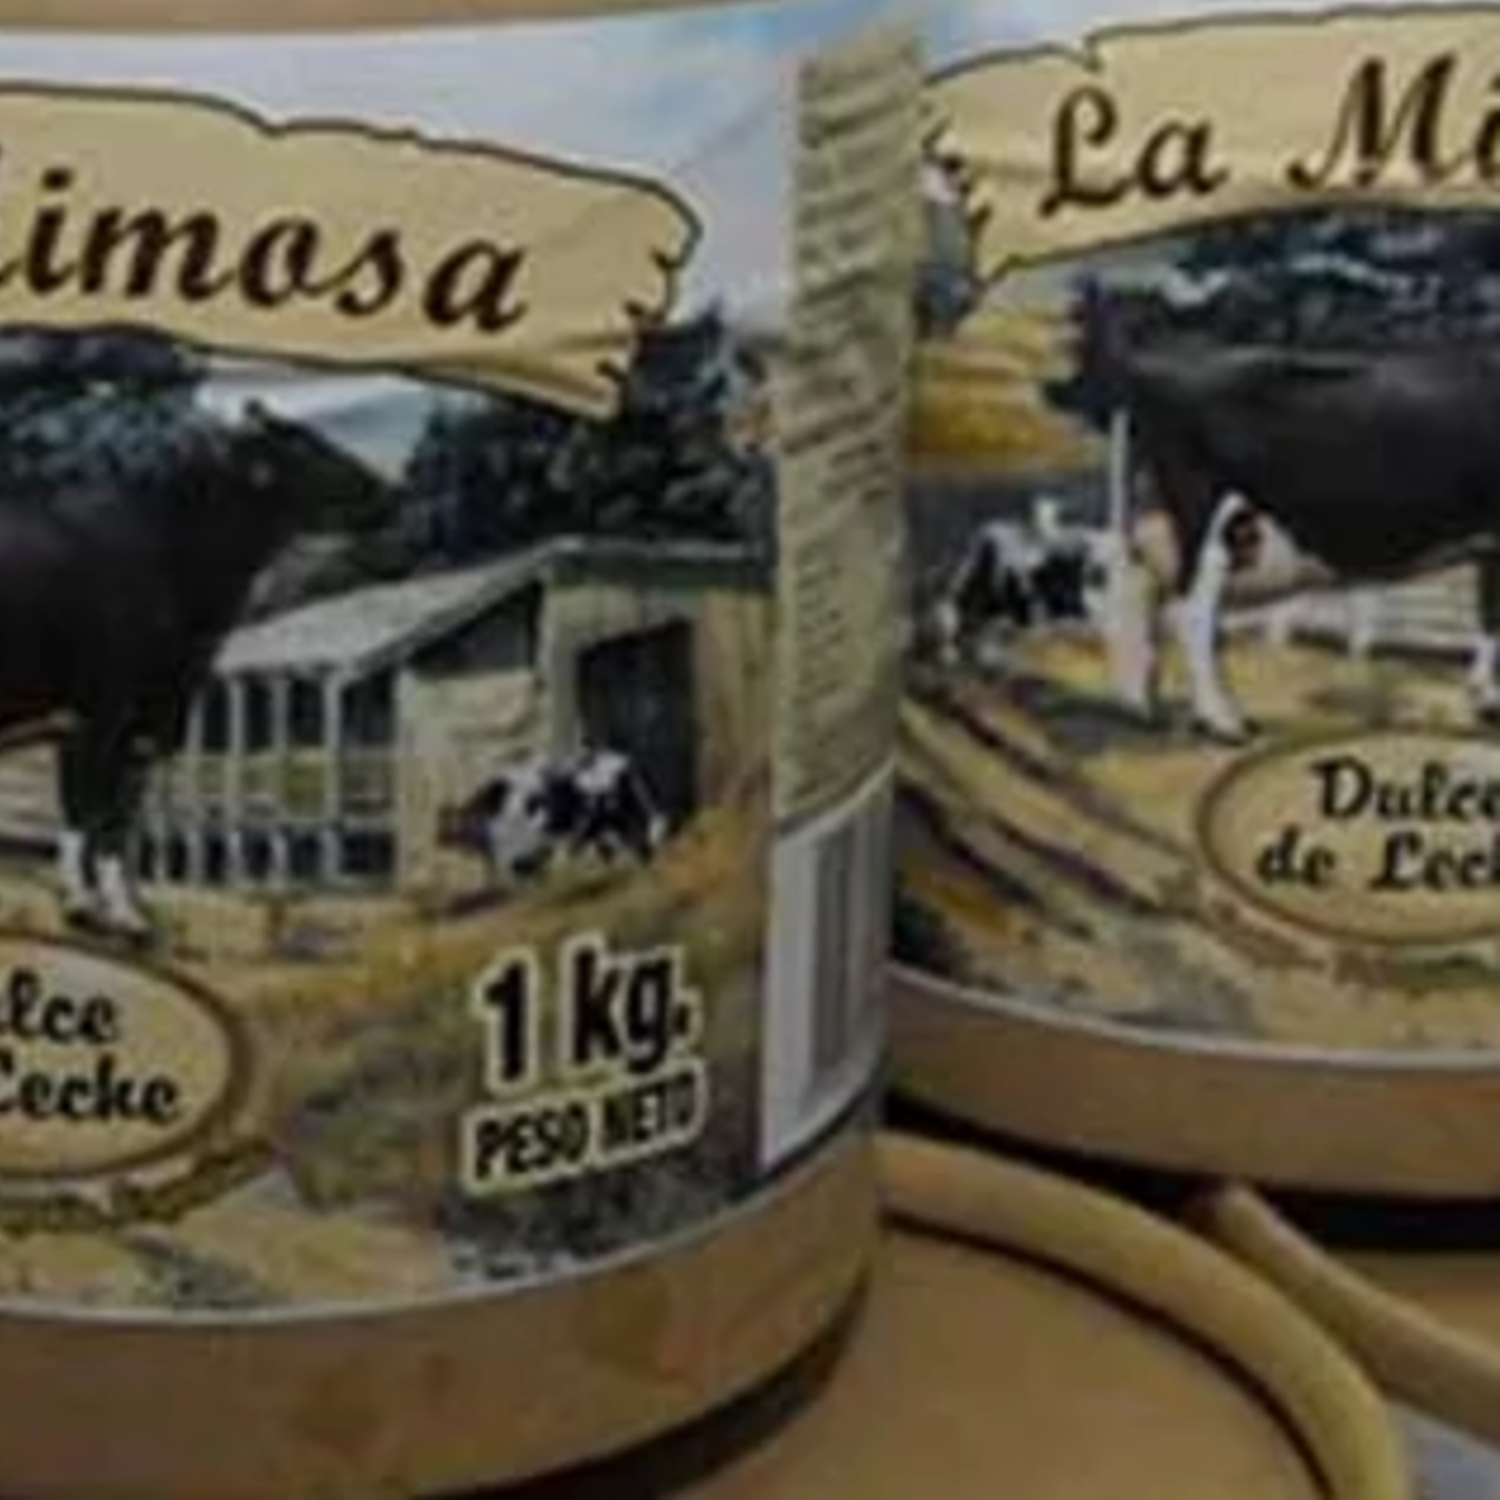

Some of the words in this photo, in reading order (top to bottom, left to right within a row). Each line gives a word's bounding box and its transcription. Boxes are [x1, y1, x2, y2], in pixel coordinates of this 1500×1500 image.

[1036, 85, 1230, 220] La
[1256, 822, 1338, 890] de
[484, 960, 526, 1086] 1
[574, 946, 692, 1076] kg.
[474, 1100, 588, 1182] PESO
[602, 1070, 696, 1146] NETO
